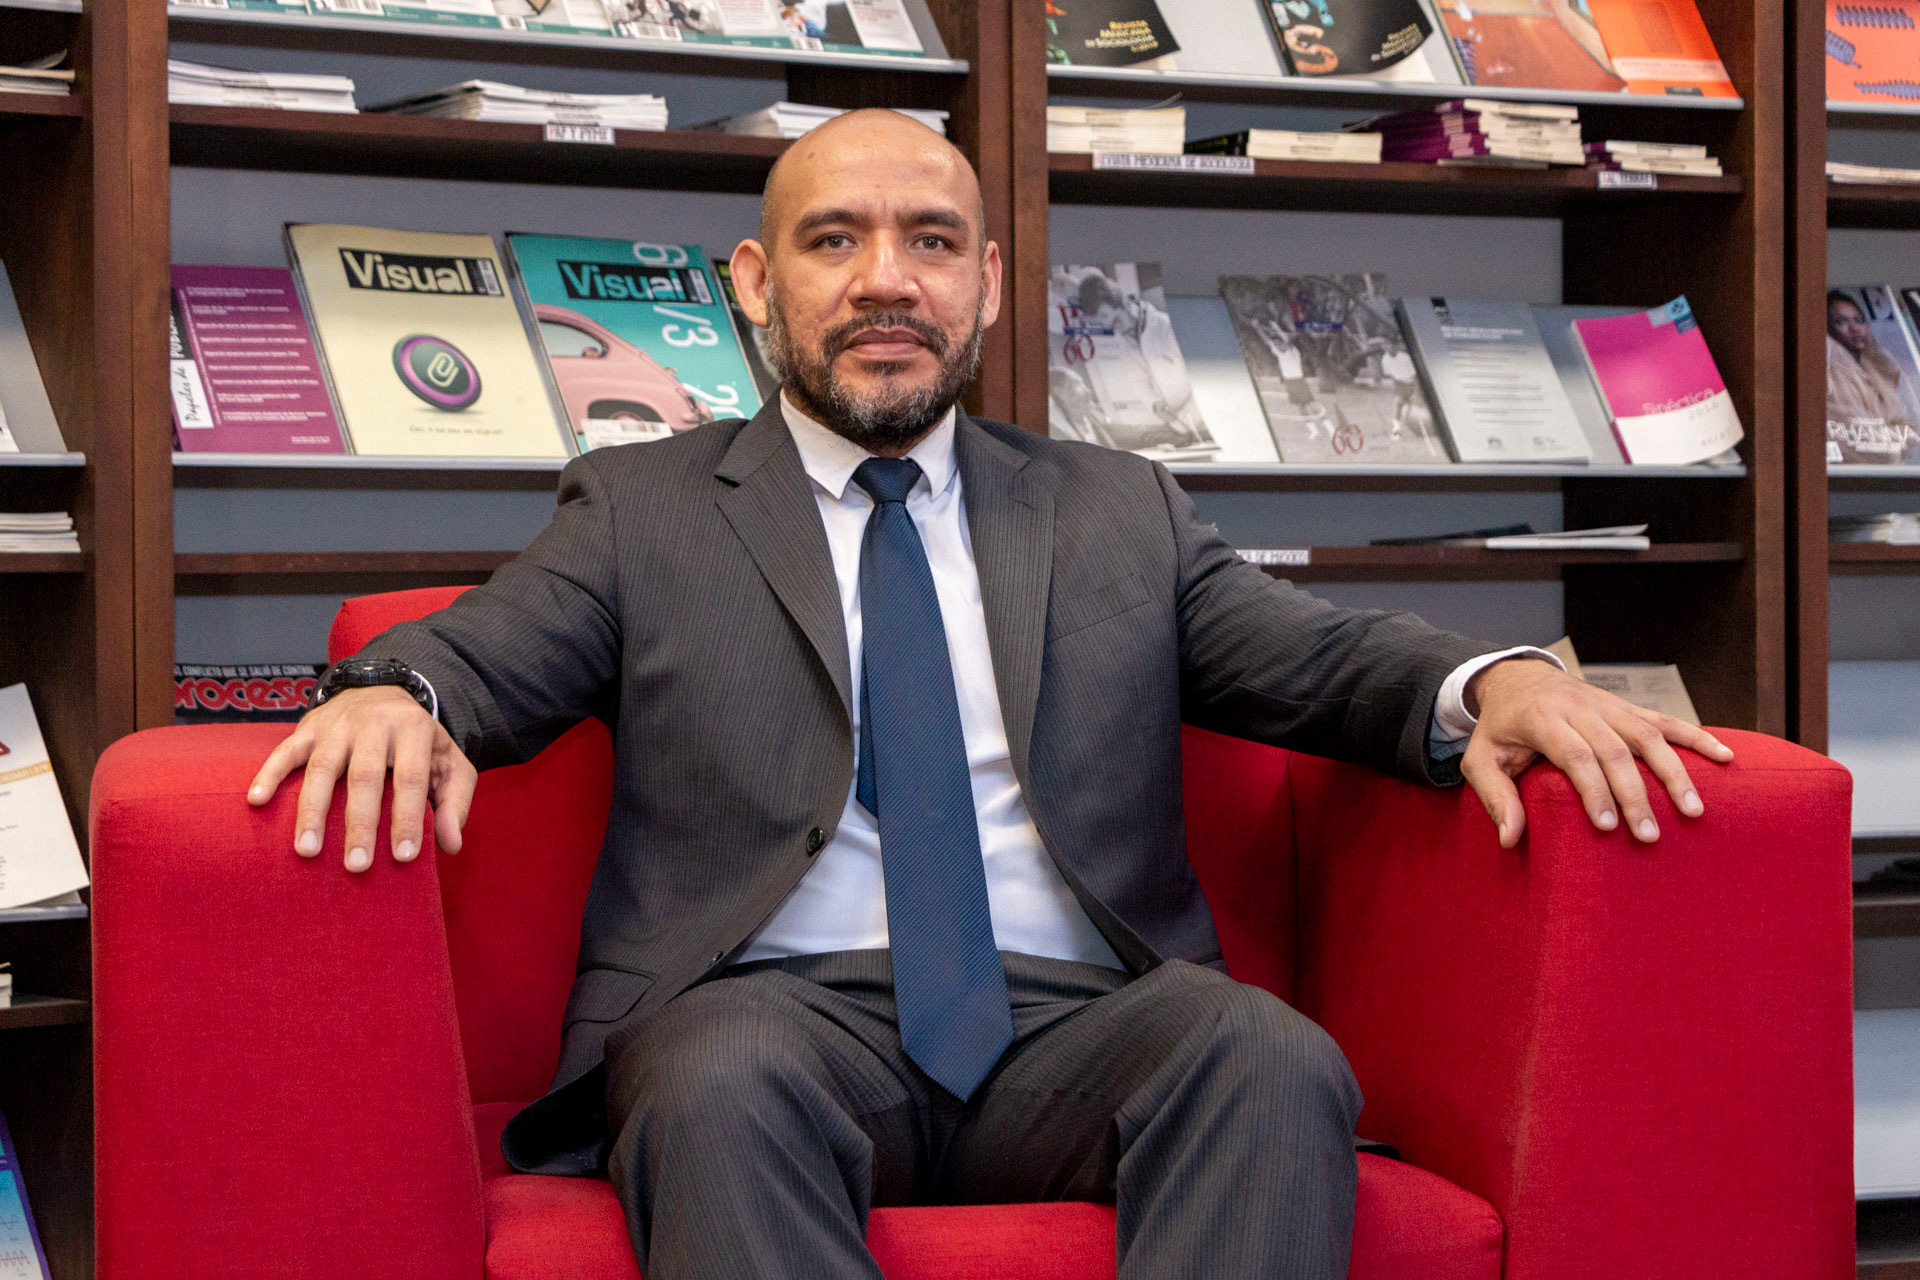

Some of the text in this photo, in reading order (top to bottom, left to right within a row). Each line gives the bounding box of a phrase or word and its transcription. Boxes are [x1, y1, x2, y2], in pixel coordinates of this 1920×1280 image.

[342, 250, 474, 294] Visual
[560, 262, 687, 301] Visual
[174, 677, 318, 710] roceso
